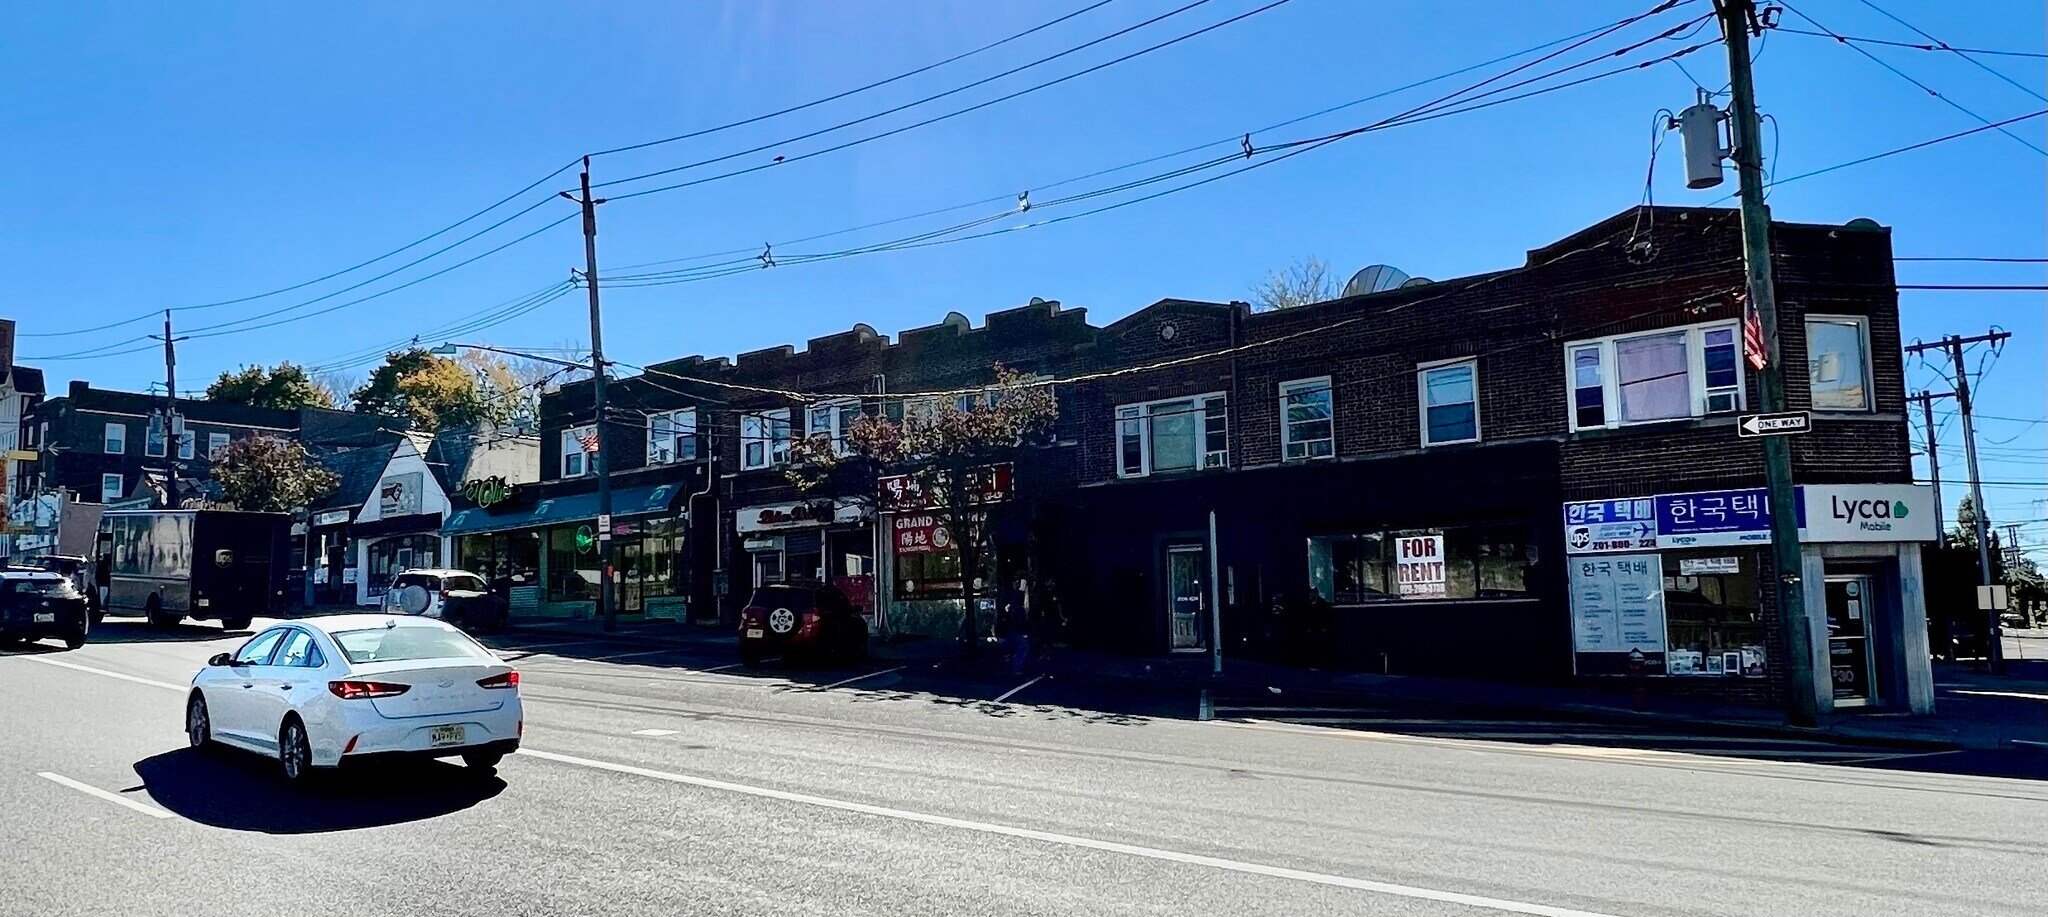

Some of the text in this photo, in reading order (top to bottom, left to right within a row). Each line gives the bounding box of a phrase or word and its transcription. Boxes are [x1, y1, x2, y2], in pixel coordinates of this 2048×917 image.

[1758, 418, 1801, 429] ONE WAY
[1669, 494, 1769, 523] 한국택
[1832, 495, 1891, 524] Lyca
[896, 516, 933, 529] GRAND
[1860, 521, 1892, 531] Mobile
[1402, 538, 1436, 558] FOR
[1571, 532, 1589, 547] ups
[1398, 562, 1443, 582] RENT
[1582, 560, 1648, 577] 한국 택배
